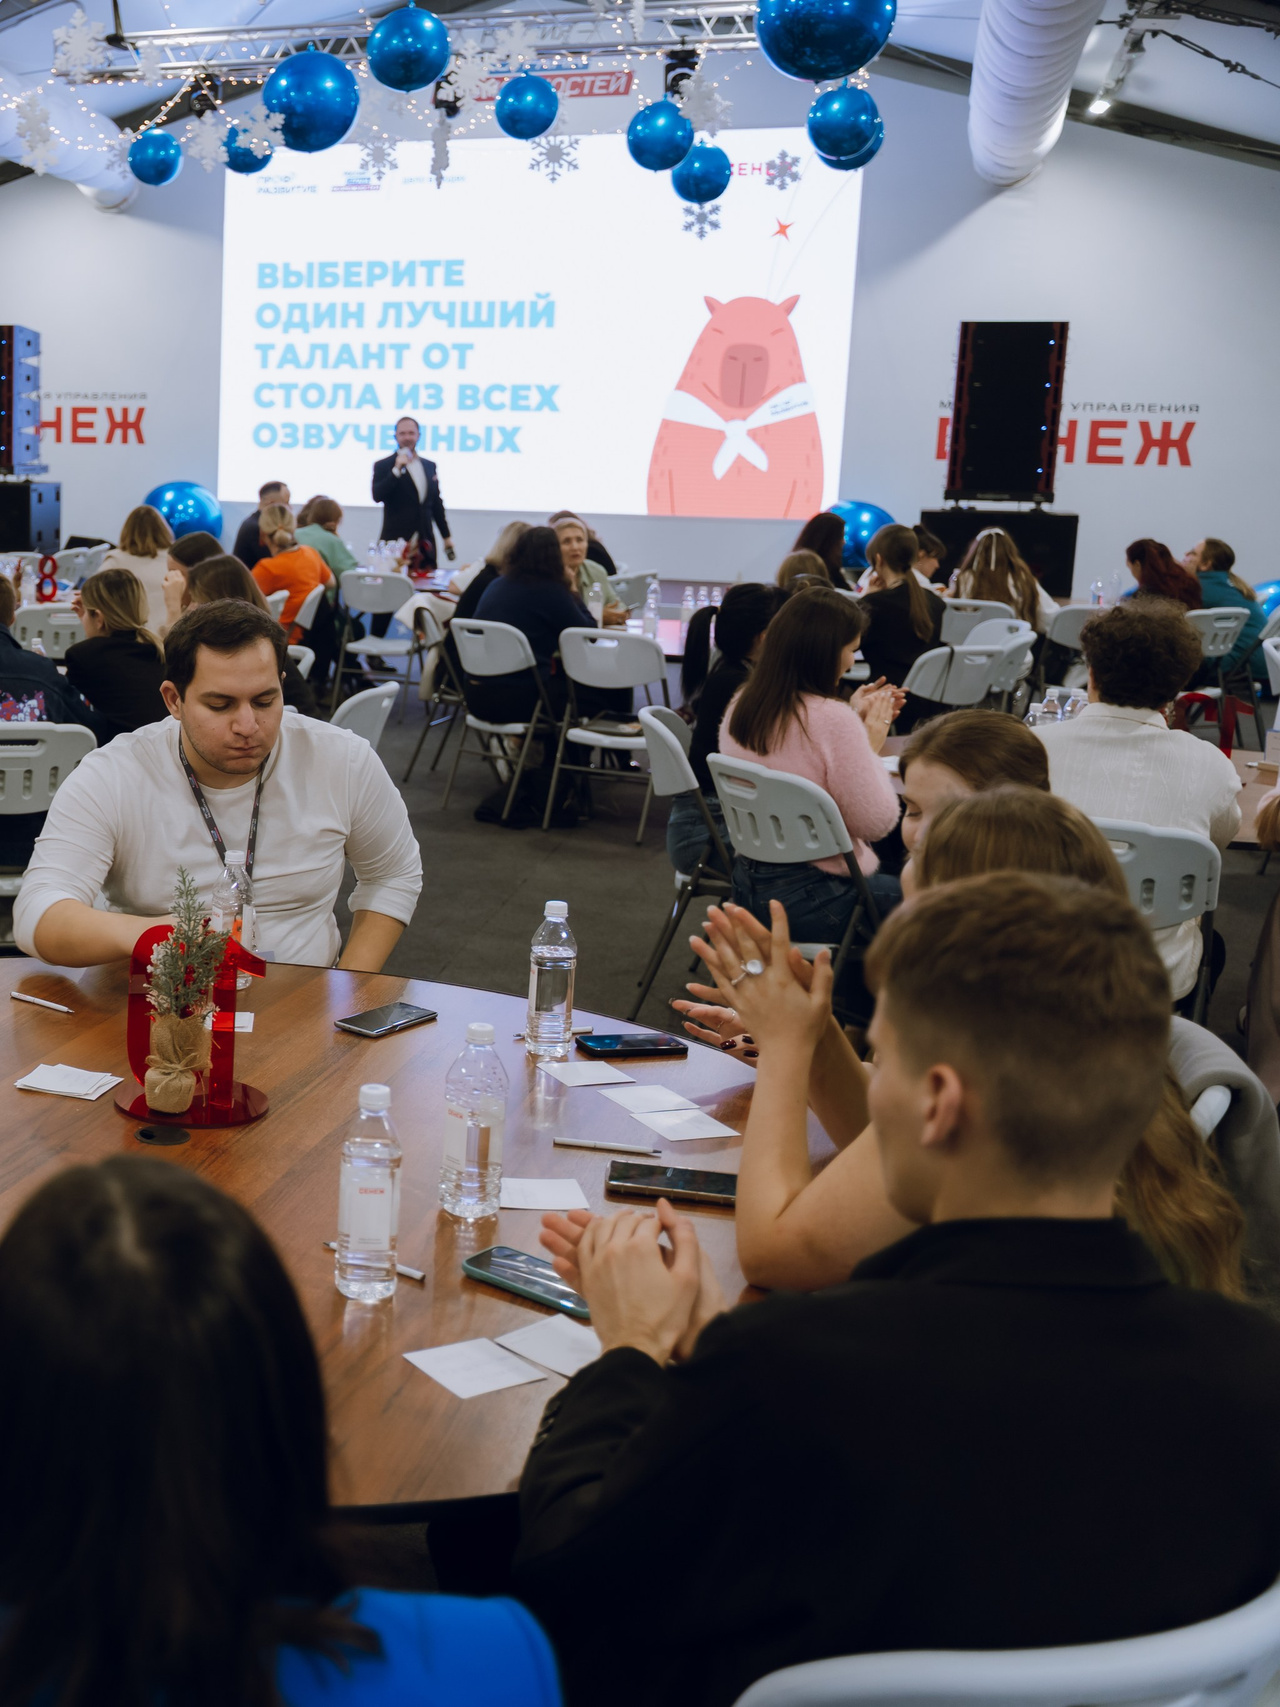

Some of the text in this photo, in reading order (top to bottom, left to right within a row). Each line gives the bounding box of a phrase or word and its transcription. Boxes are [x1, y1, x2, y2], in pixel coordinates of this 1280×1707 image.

[257, 259, 465, 290] ВЫБЕРИТЕ
[255, 293, 556, 334] ОДИН ЛУЧШИЙ
[254, 342, 475, 371] ТАЛАНТ ОТ
[56, 392, 147, 400] УПРАВЛЕНИЯ
[253, 382, 560, 412] СТОЛА ИЗ ВСЕХ
[1071, 402, 1200, 414] УПРАВЛЕНИЯ
[34, 407, 145, 444] НЕЖ
[252, 422, 522, 454] ОЗВУЧЕНЫХ
[38, 554, 58, 602] 8
